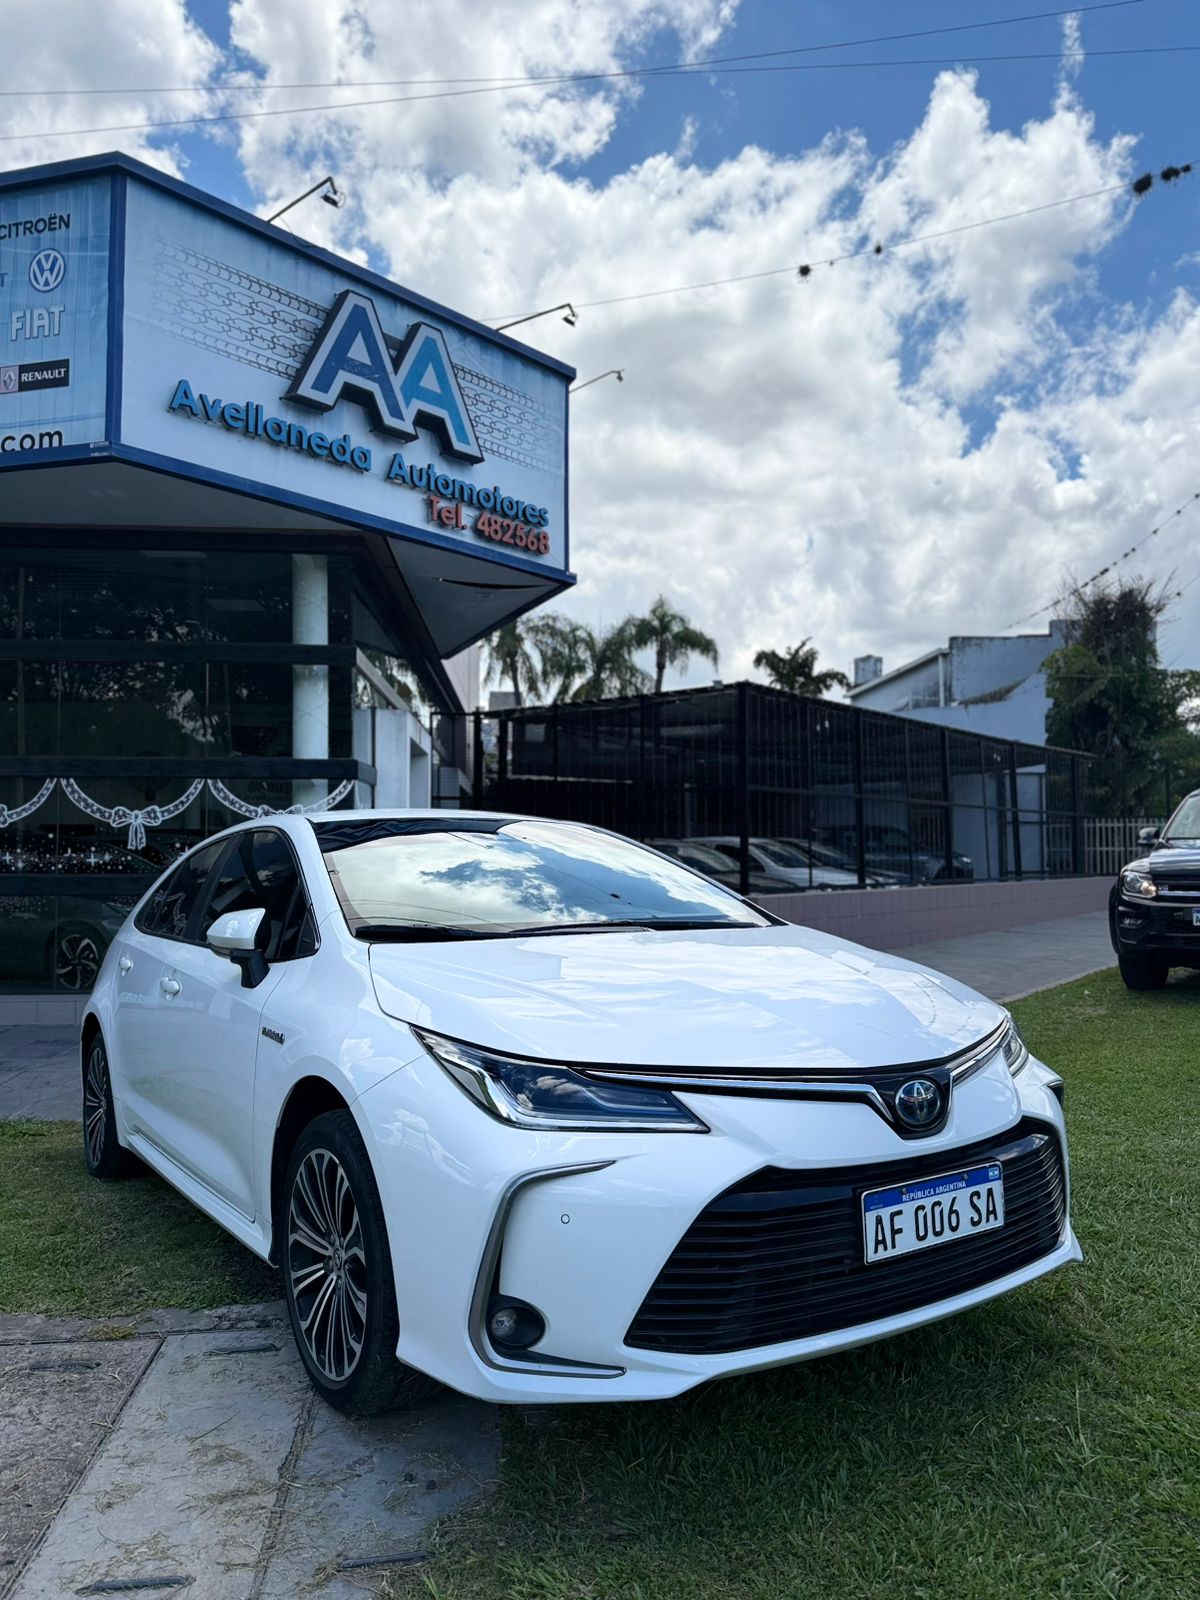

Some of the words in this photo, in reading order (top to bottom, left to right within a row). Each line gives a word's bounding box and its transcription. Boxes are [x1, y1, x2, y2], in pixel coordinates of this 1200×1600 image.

[0, 213, 71, 240] CITROËN
[10, 304, 65, 341] FIAT
[21, 367, 67, 382] RENAULT
[287, 289, 485, 465] AA
[169, 378, 371, 472] Avellaneda
[387, 452, 549, 527] Automotores
[427, 495, 468, 530] Tel.
[475, 511, 550, 555] 482568
[902, 1189, 935, 1202] REPÚBLICA
[935, 1180, 967, 1194] ARGENTINA
[873, 1209, 904, 1255] AF
[914, 1195, 961, 1242] 006
[969, 1187, 999, 1228] SA
